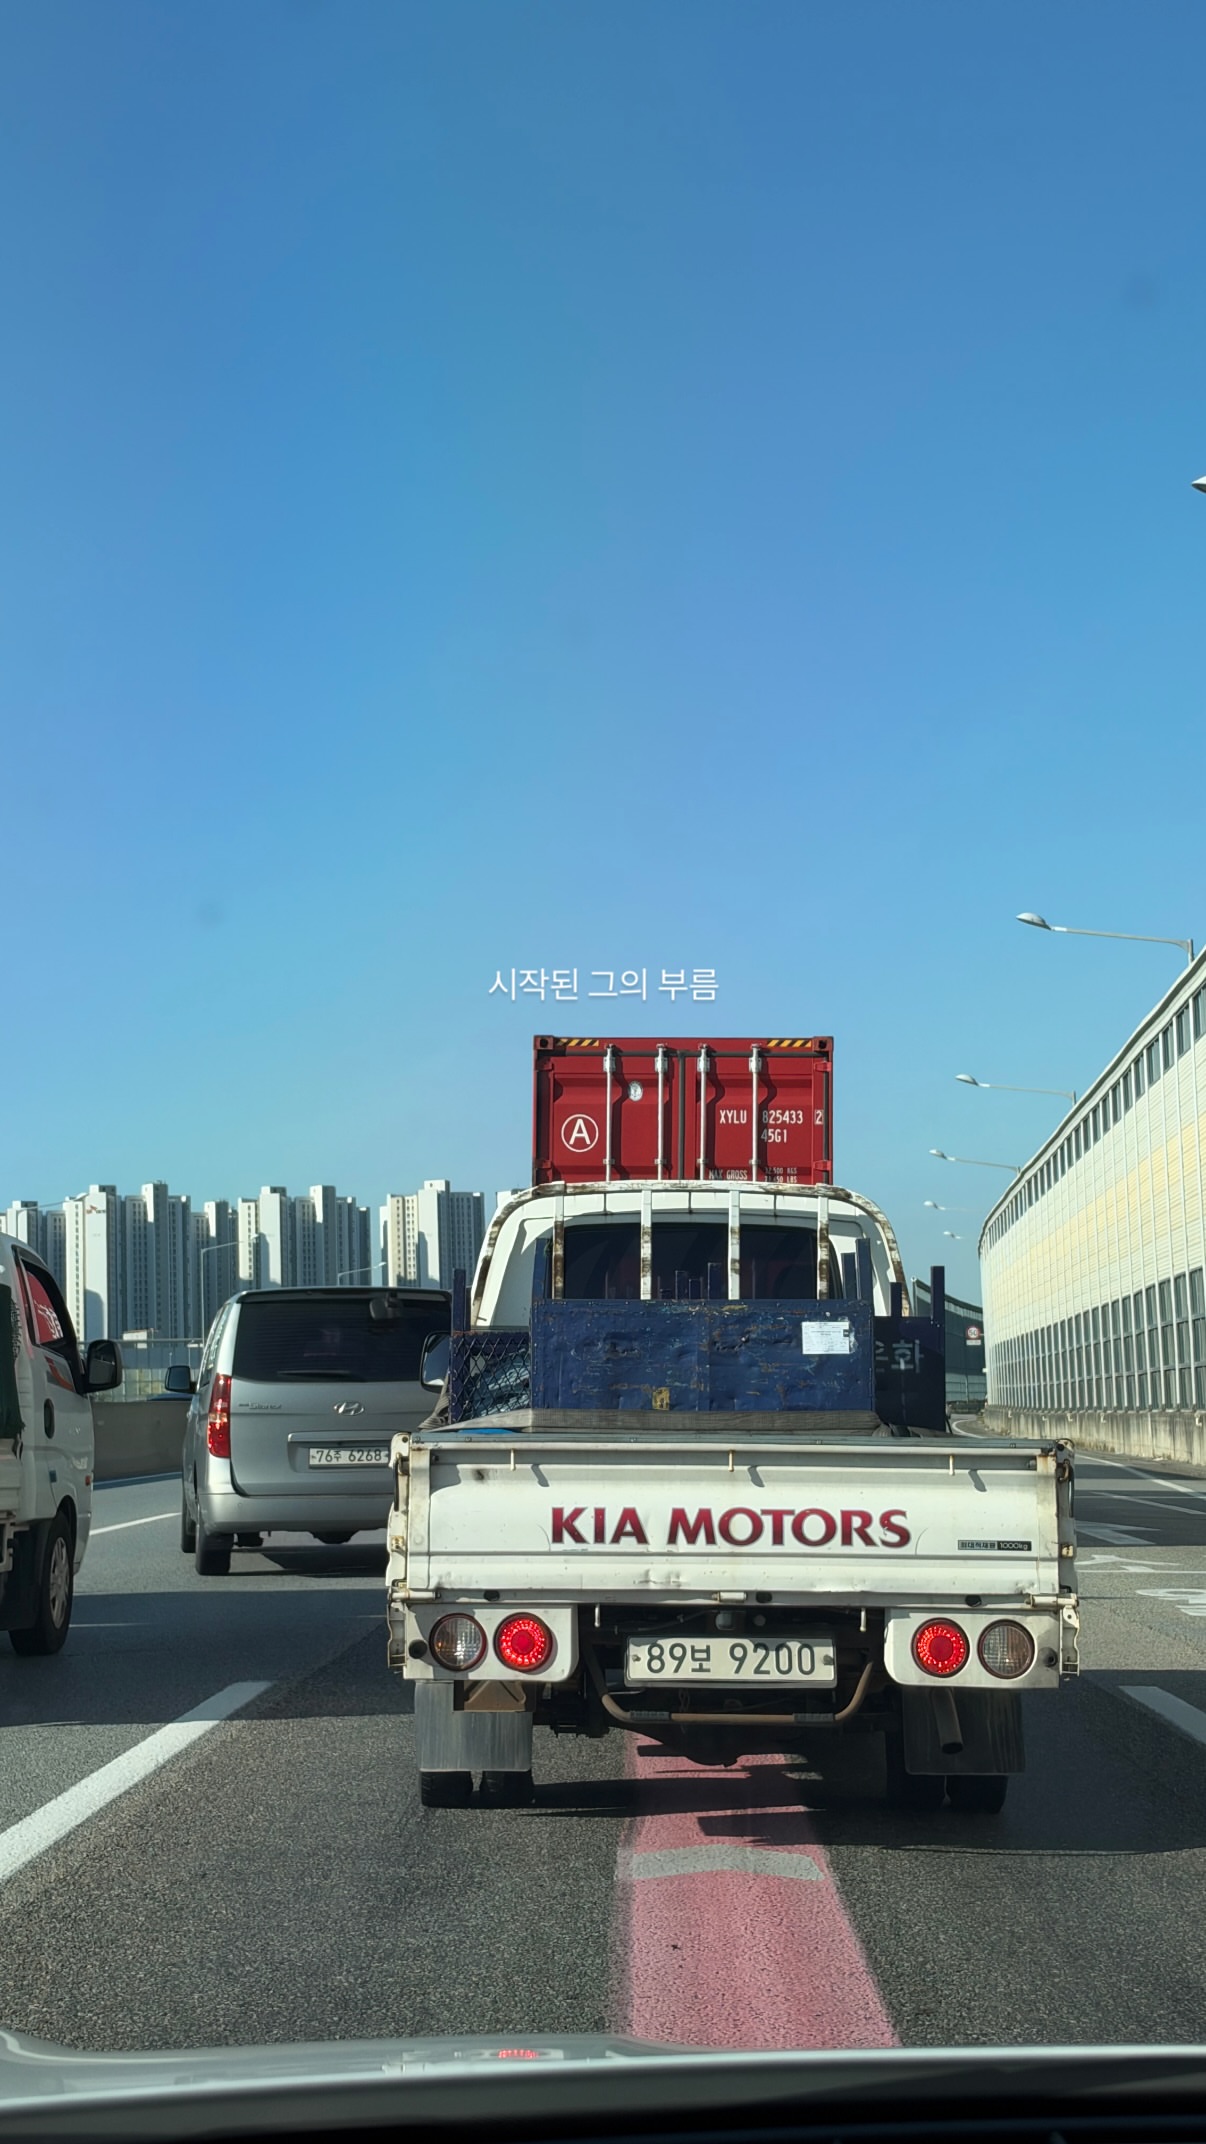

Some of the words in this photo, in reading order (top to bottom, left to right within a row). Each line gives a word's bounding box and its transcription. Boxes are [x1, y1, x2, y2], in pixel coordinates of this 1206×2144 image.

[719, 1109, 747, 1124] XYLU
[762, 1109, 804, 1124] 825433
[815, 1110, 823, 1124] 2
[760, 1128, 787, 1143] 45G1
[726, 1169, 748, 1180] GROSS
[348, 1449, 382, 1462] 6268
[551, 1506, 650, 1545] KIA
[666, 1507, 912, 1549] MOTORS
[999, 1542, 1029, 1550] 1000kg
[646, 1642, 711, 1674] 89보
[729, 1642, 815, 1676] 9200
